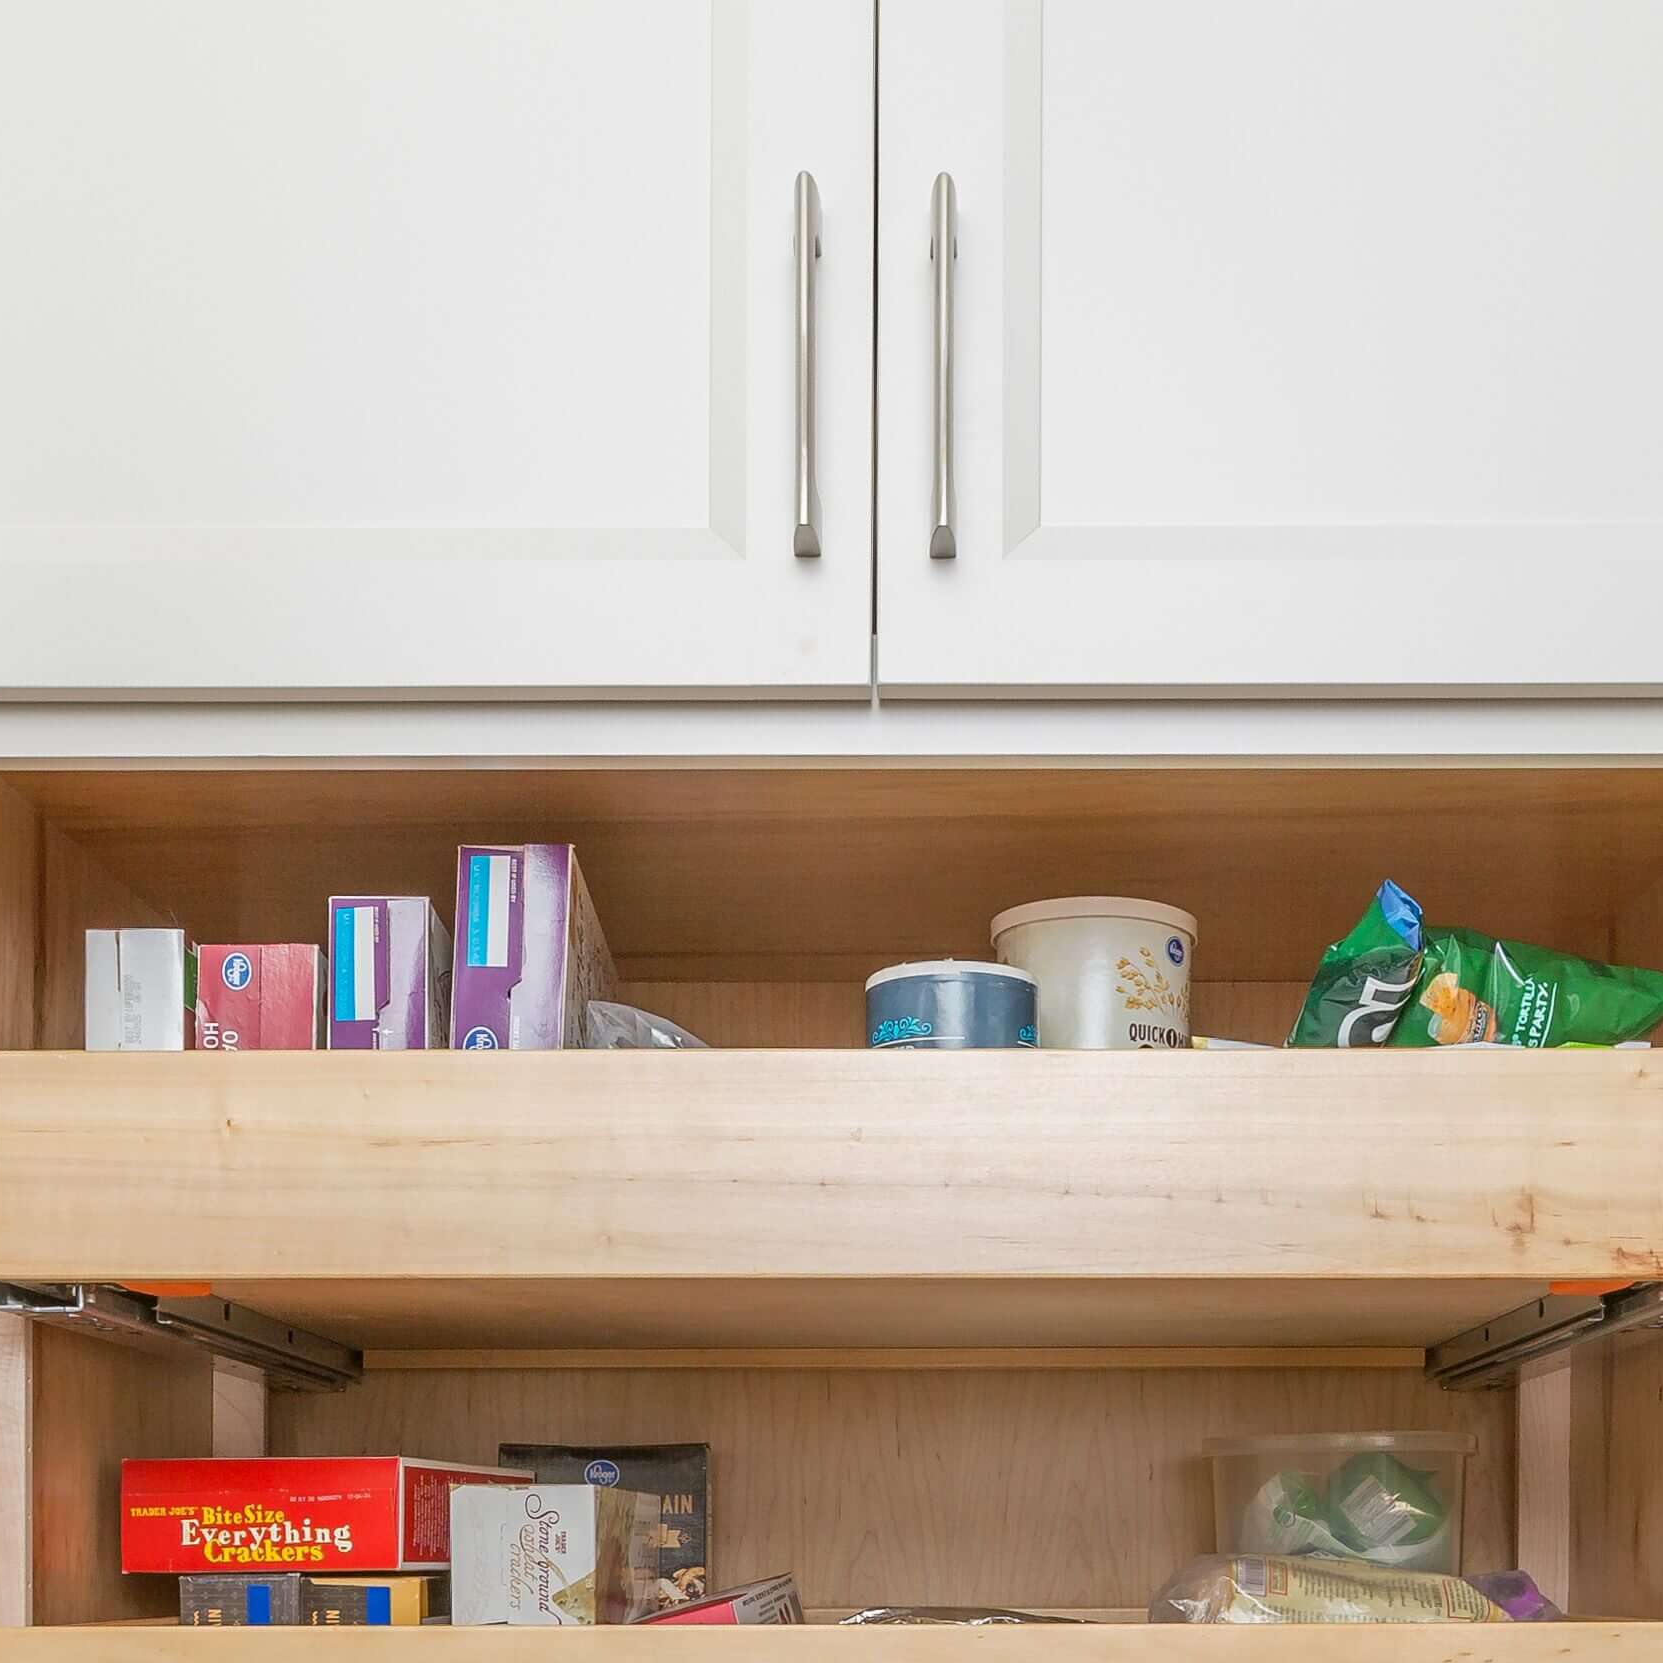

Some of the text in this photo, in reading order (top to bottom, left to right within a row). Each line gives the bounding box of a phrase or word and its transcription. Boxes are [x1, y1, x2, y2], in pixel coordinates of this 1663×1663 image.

[1129, 1023, 1165, 1044] QUICK
[588, 1463, 616, 1487] Kroger
[130, 1506, 195, 1517] TRADER JOE'S
[202, 1503, 285, 1525] Bite Size
[181, 1518, 352, 1552] Everything
[204, 1538, 324, 1563] Crackers
